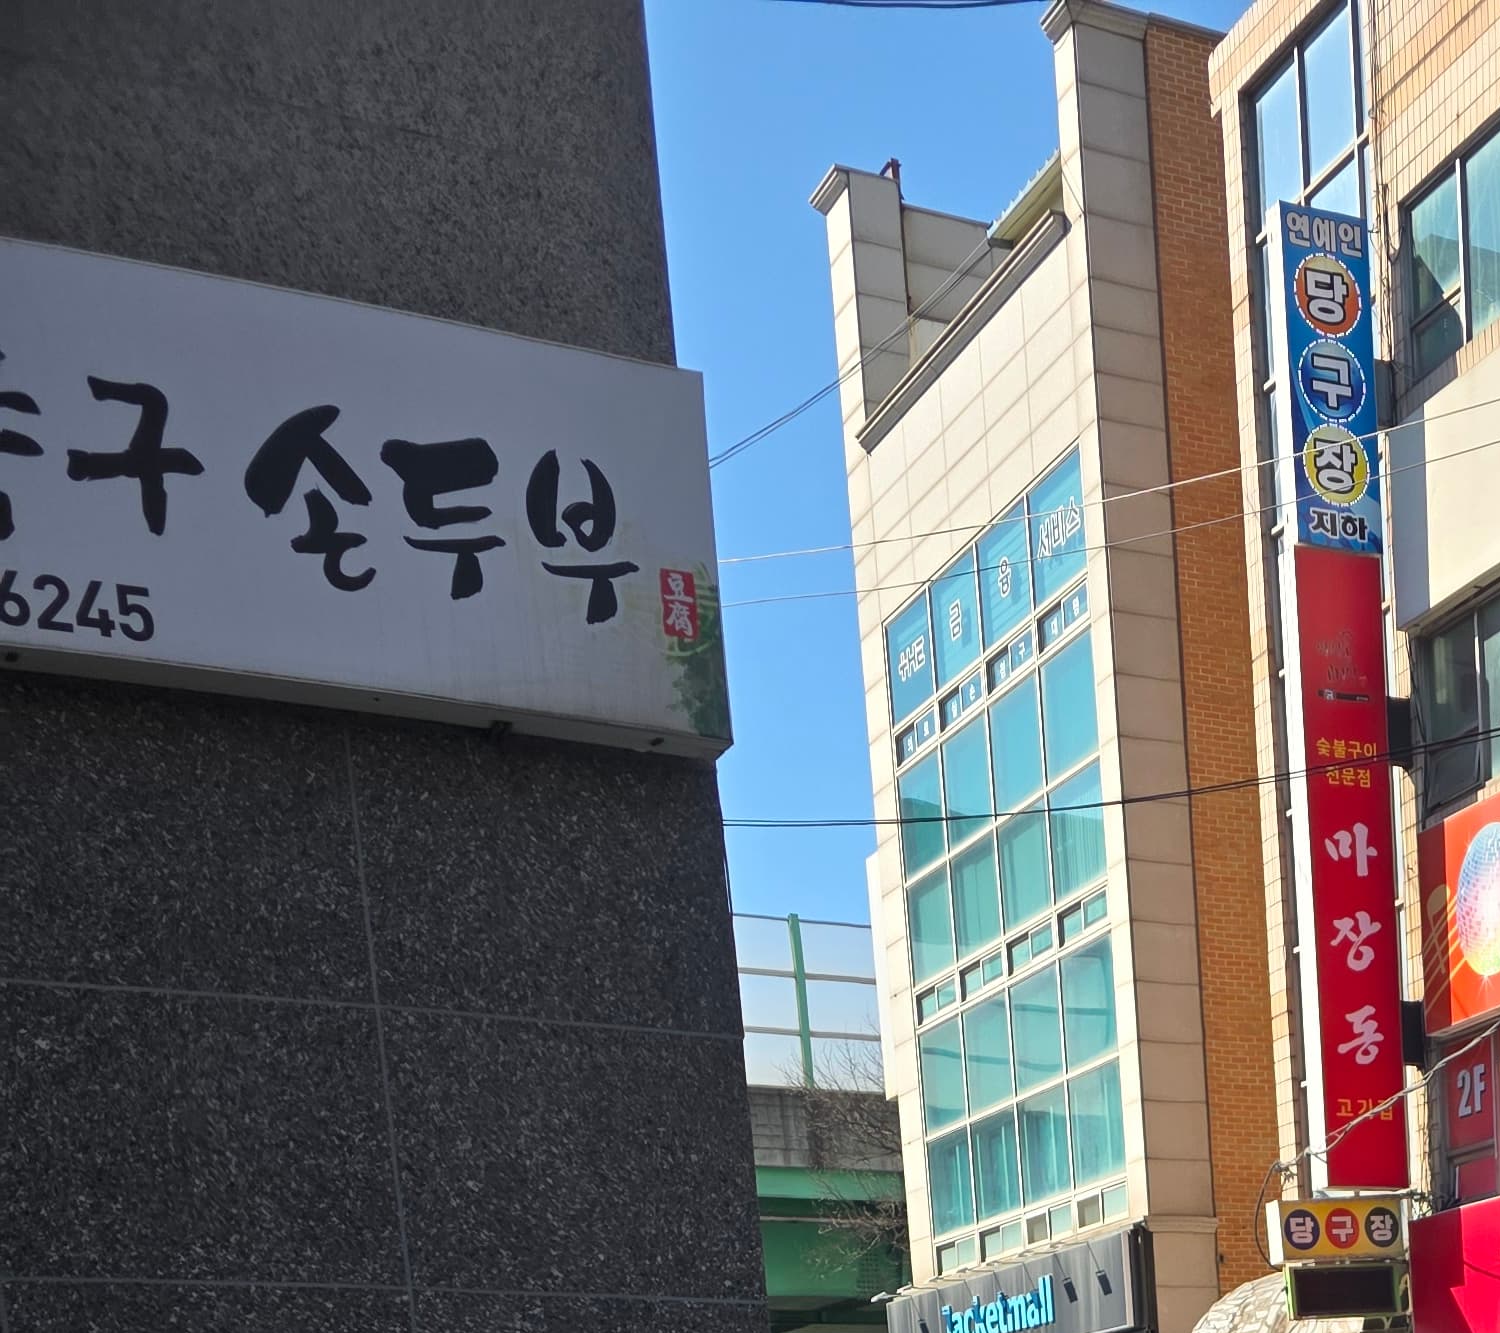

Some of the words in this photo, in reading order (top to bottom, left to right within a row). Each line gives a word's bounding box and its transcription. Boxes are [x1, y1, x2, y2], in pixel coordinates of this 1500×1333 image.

[1285, 210, 1363, 260] 연예인
[1303, 266, 1357, 496] 당구장
[244, 404, 640, 625] 손두부
[1037, 495, 1082, 562] 서비스
[1310, 507, 1370, 543] 지하
[661, 569, 697, 640] 豆腐
[1316, 736, 1377, 762] 숯불구이
[1325, 766, 1371, 789] 전문점
[1324, 821, 1386, 1067] 마장동
[1335, 1097, 1395, 1122] 고기집
[1456, 1063, 1487, 1119] 2F
[1288, 1211, 1396, 1246] 당구장
